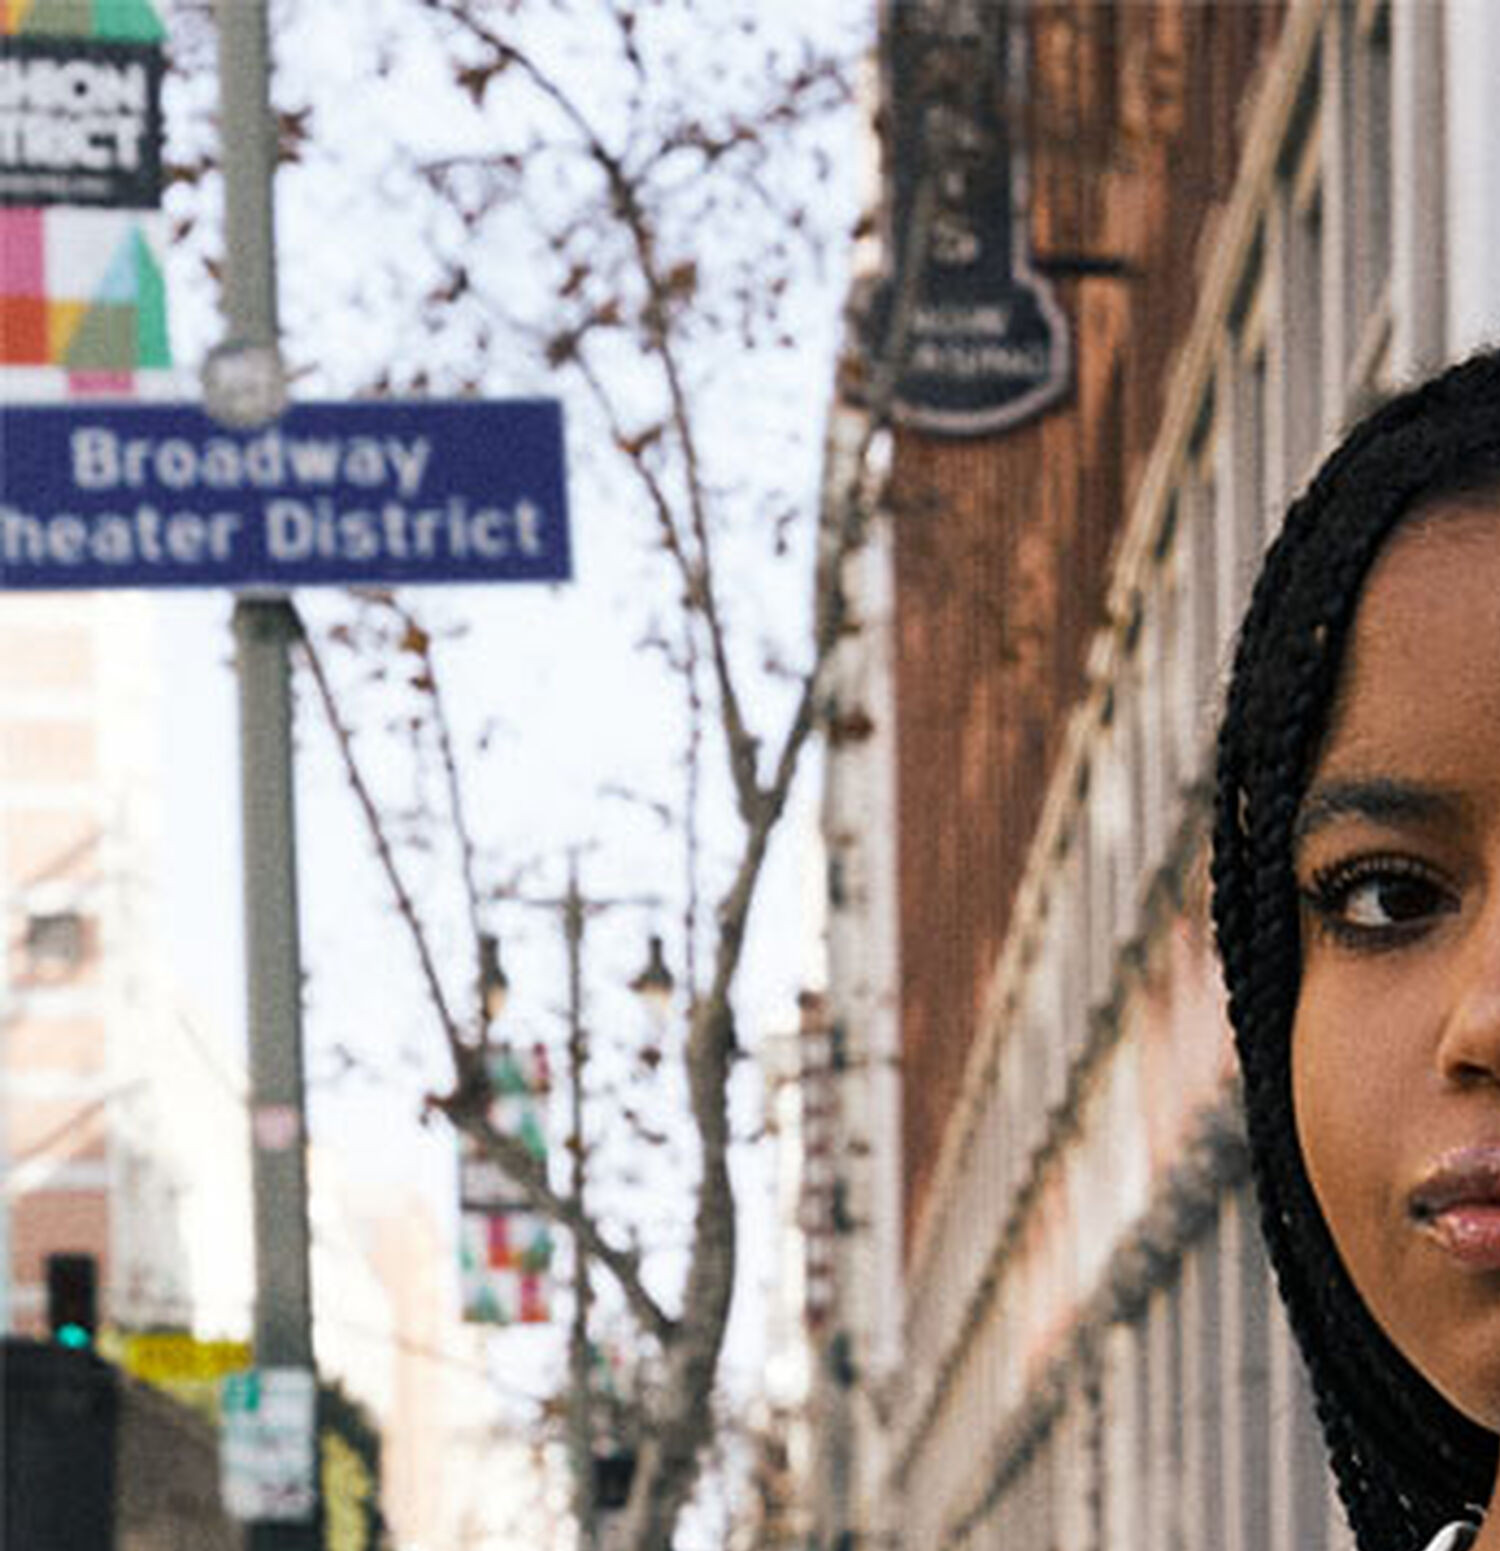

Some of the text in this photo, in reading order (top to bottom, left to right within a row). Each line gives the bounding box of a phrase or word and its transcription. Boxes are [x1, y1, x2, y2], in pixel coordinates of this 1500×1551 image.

[69, 425, 431, 496] Broadway
[0, 497, 543, 564] heater District
